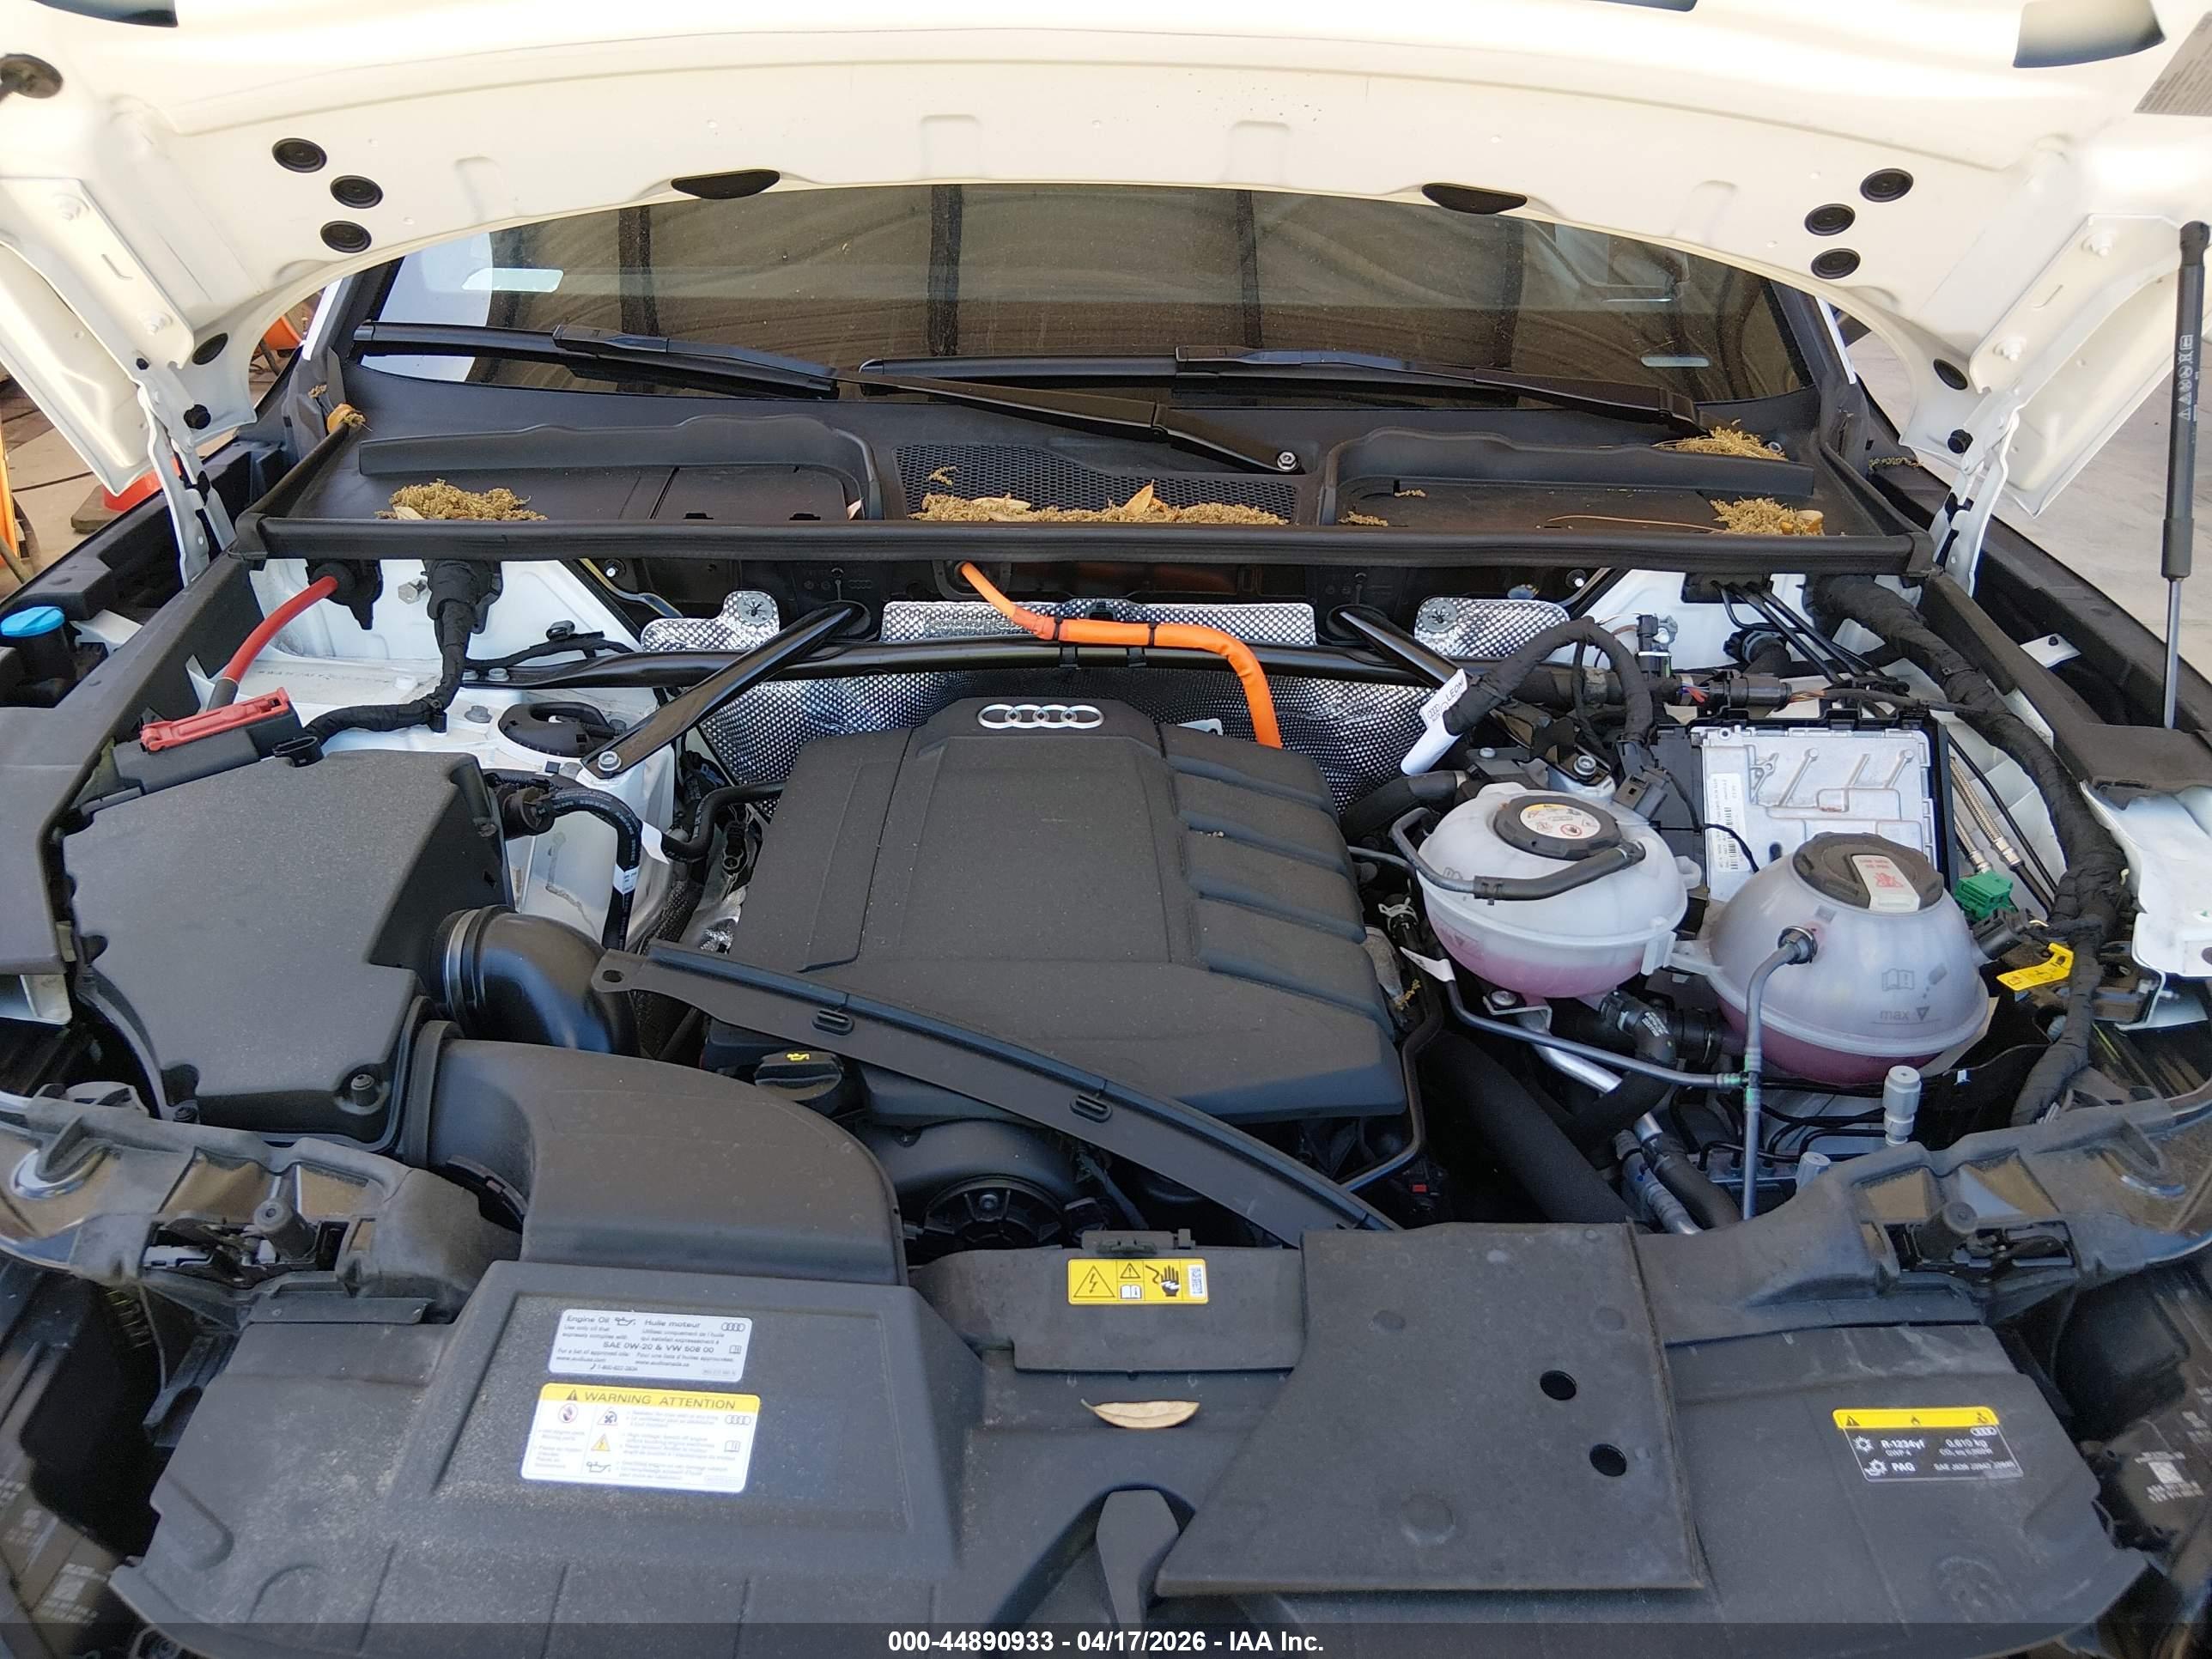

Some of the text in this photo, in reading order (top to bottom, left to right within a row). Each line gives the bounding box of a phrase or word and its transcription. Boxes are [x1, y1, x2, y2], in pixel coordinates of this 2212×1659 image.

[1880, 1009, 1911, 1020] max
[585, 1391, 736, 1410] WARNING ATTENTION
[1891, 1462, 1916, 1472] PAG
